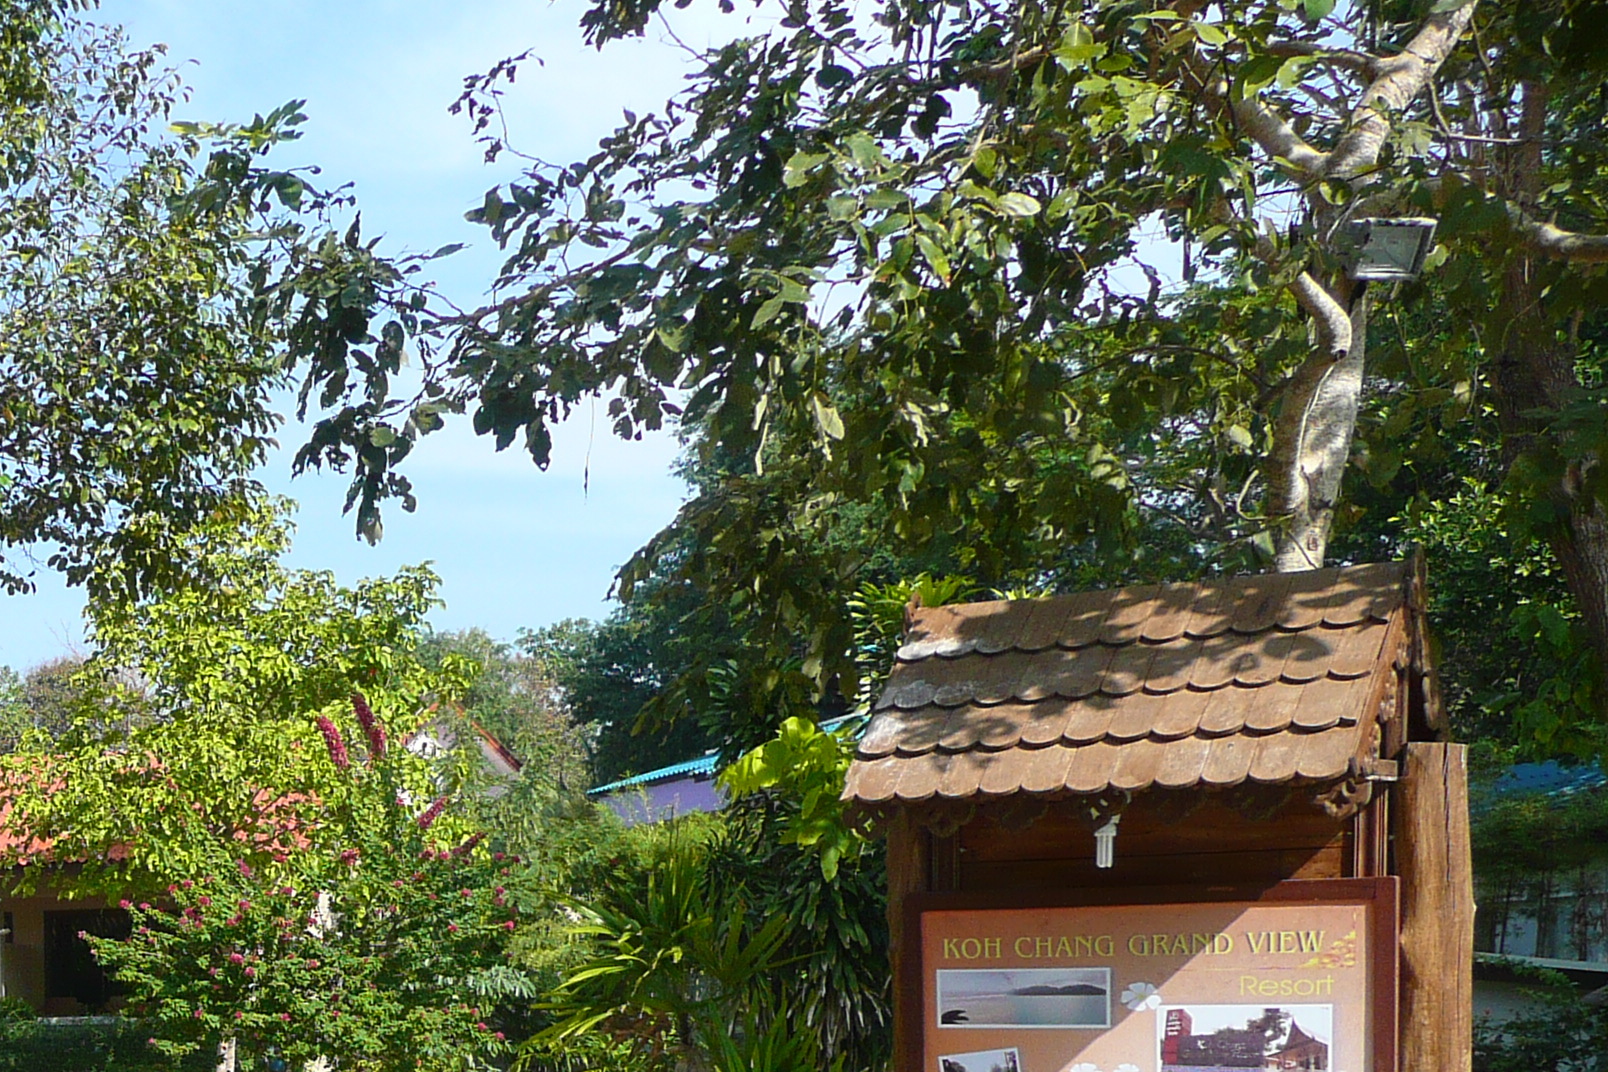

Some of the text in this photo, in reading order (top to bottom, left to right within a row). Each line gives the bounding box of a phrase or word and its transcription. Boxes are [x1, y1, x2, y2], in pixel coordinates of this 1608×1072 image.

[943, 929, 1325, 960] KOH CHANG GRAND VIEW
[1239, 974, 1334, 997] Resort
